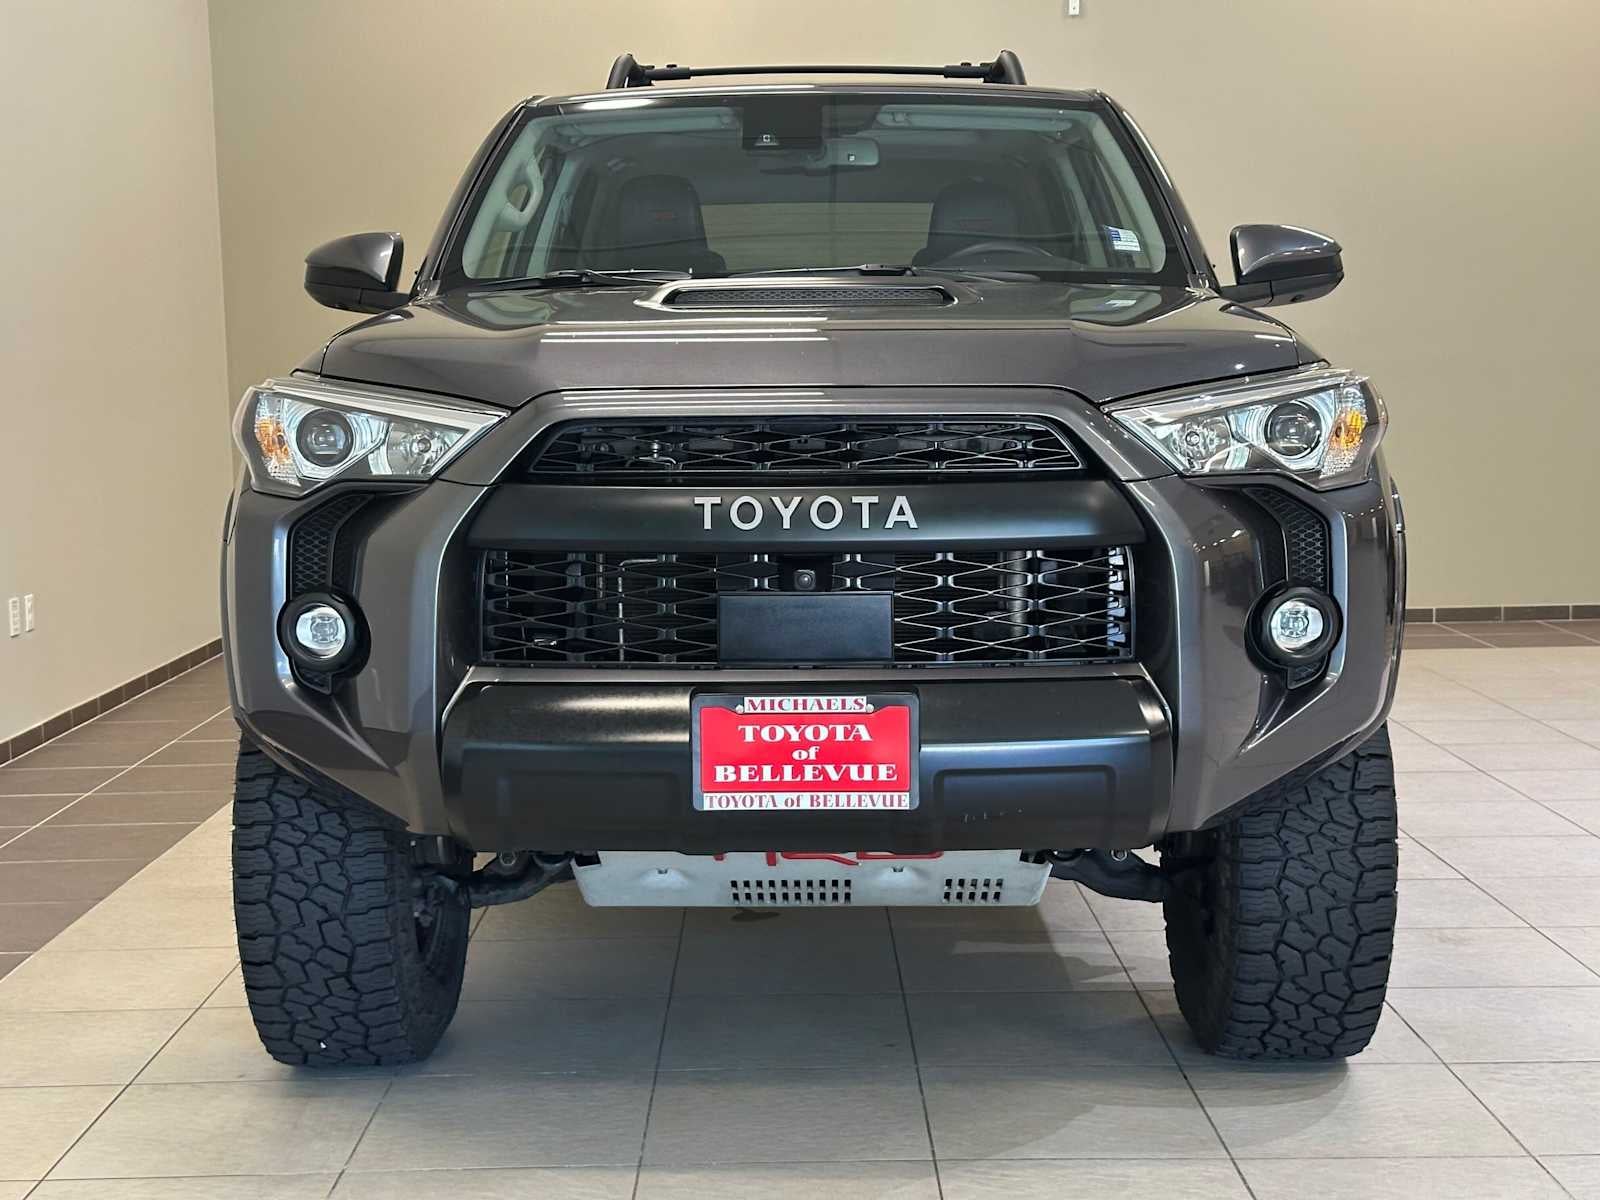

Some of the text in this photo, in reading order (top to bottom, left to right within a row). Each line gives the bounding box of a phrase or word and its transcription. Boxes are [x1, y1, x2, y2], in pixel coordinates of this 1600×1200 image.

[694, 495, 918, 530] TOYOTA
[747, 698, 865, 711] MICHAELS
[738, 724, 872, 742] TOYOTA
[792, 746, 820, 760] of
[714, 764, 898, 782] BELLEVUE
[705, 794, 908, 808] TOYOTA of BELLEVUE
